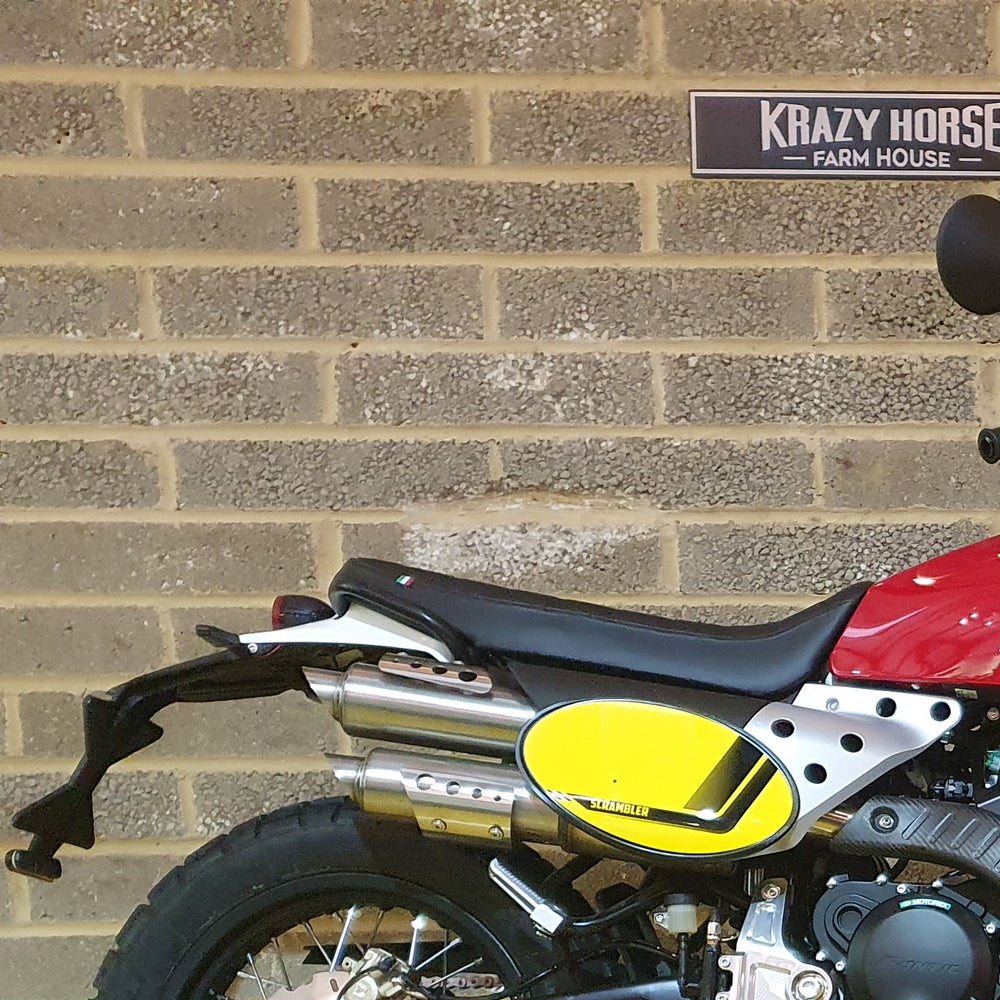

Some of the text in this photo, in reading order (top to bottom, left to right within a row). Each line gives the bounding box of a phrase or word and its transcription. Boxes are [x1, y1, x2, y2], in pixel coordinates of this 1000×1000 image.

[761, 99, 881, 151] KRAZY
[813, 148, 951, 168] FARM HOUSE
[589, 799, 650, 818] SCRAMBLER
